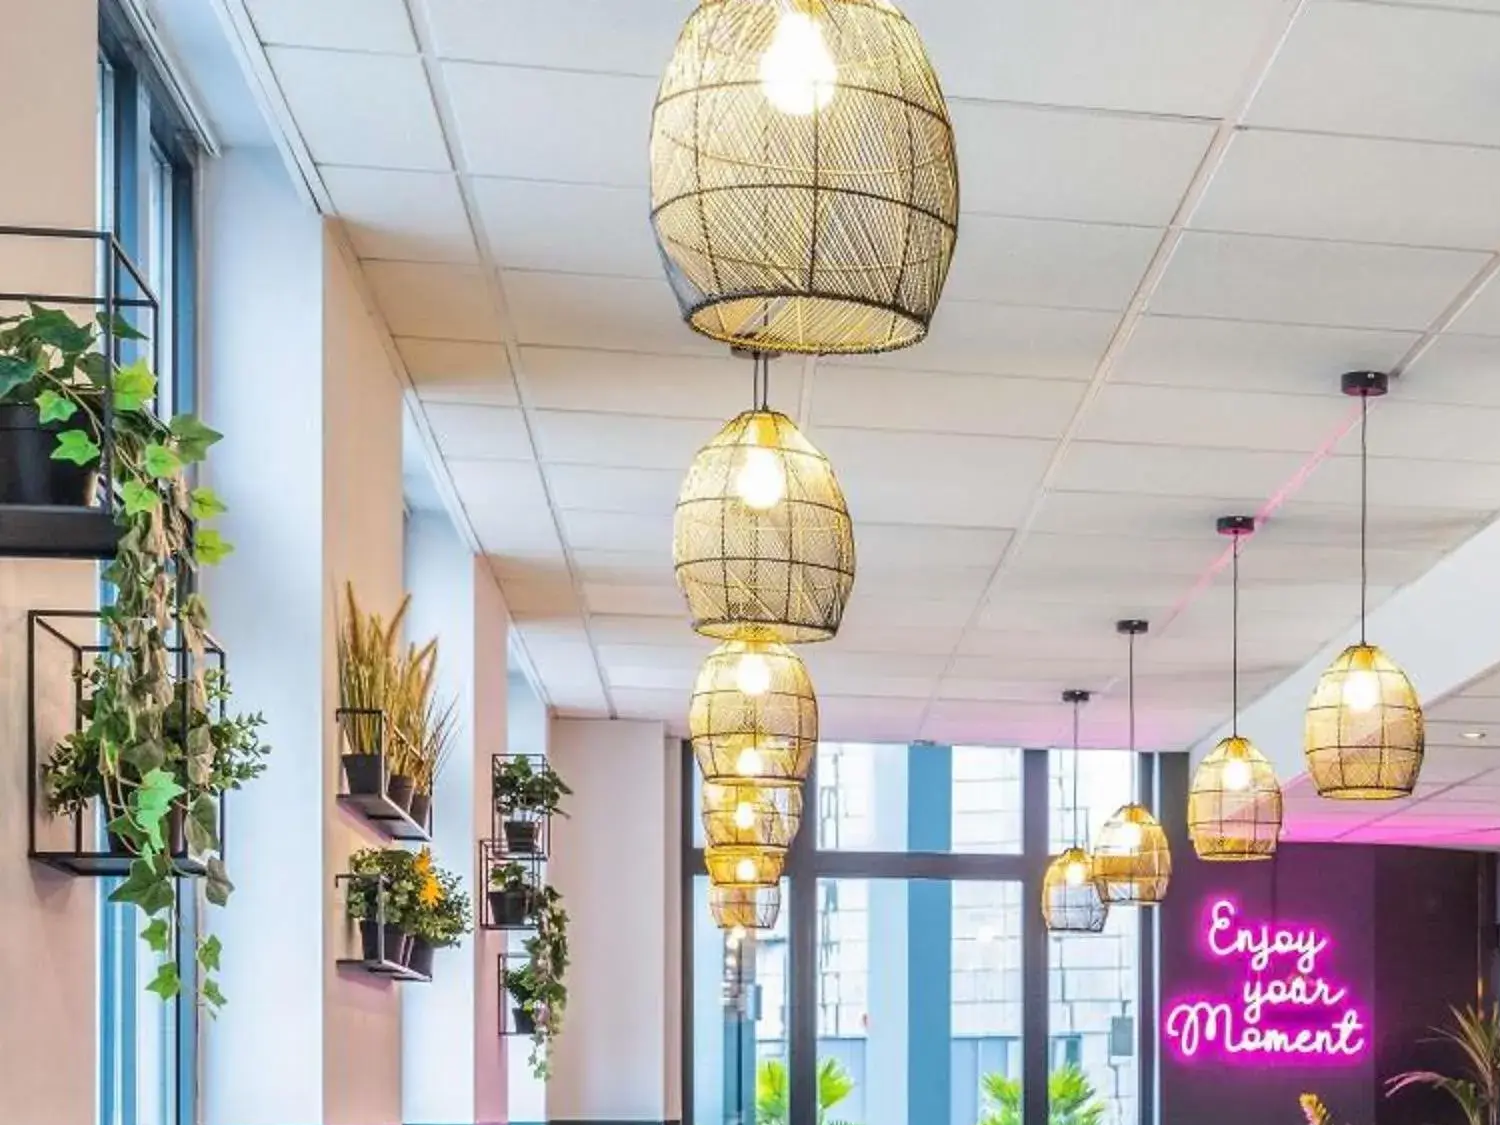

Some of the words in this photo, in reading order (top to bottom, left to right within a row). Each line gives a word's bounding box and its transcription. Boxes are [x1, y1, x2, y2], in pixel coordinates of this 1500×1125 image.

[1208, 900, 1328, 972] Enjoy
[1243, 976, 1347, 1022] your
[1167, 1002, 1365, 1055] Moment
